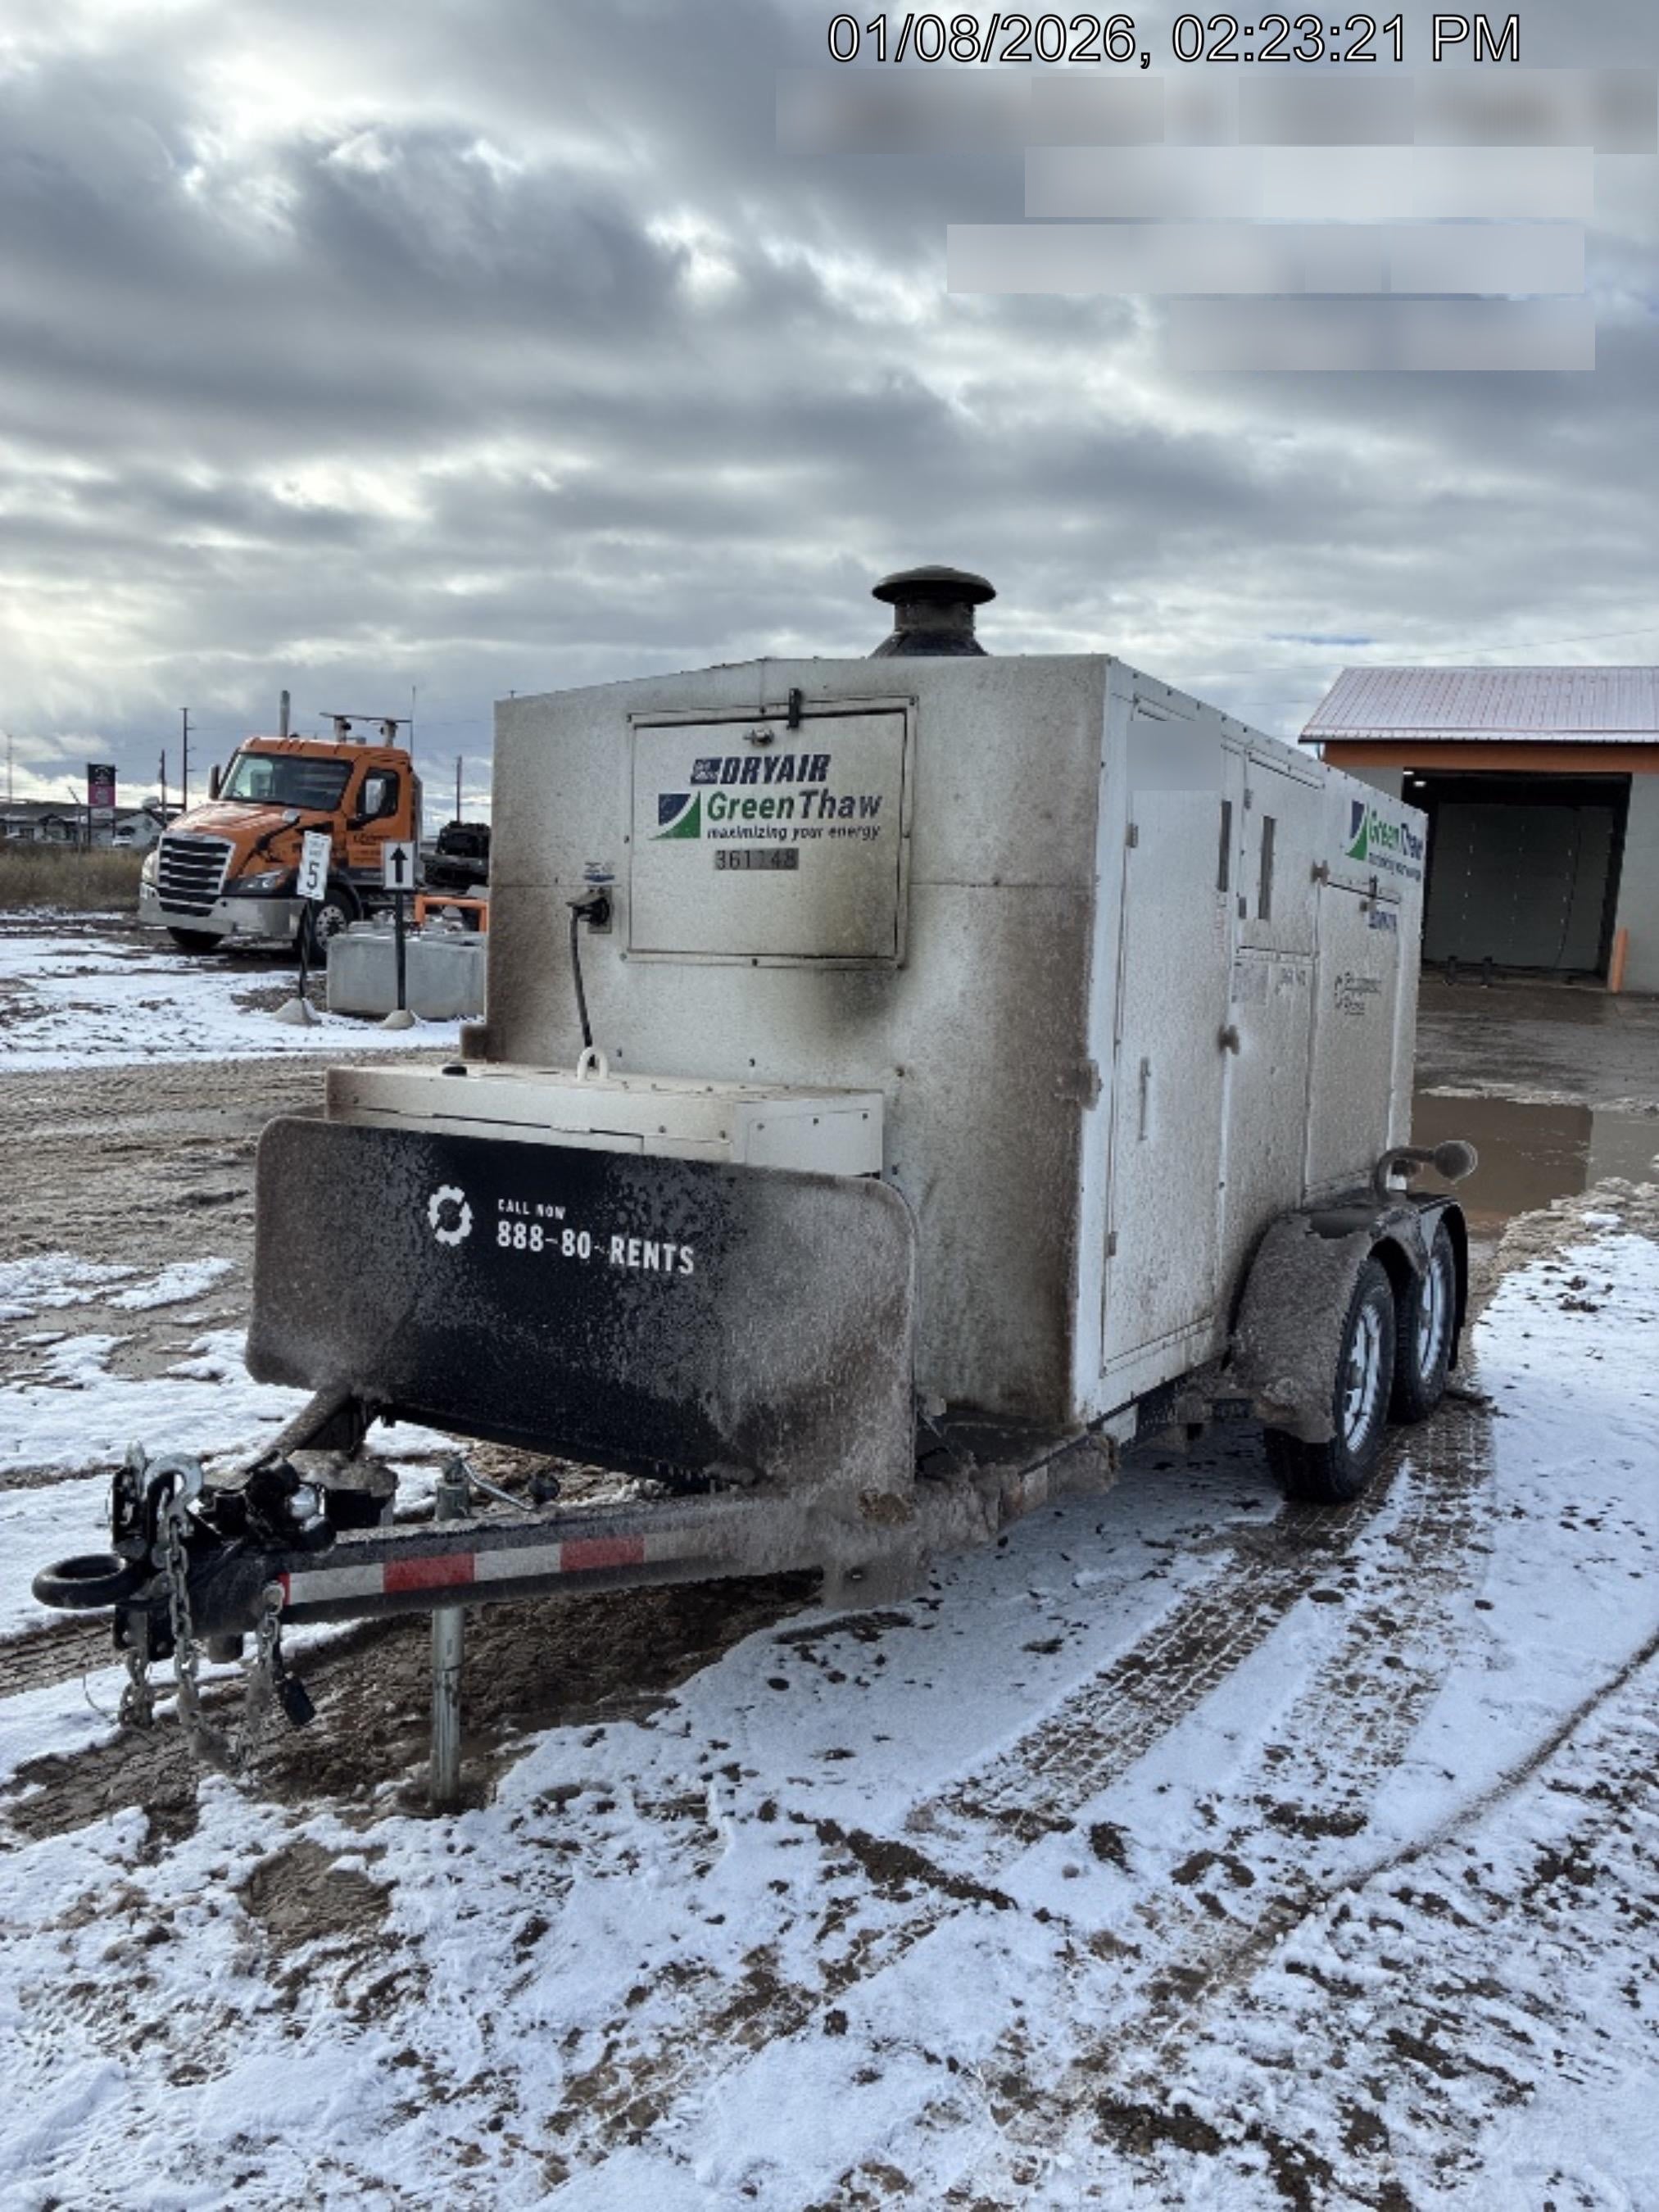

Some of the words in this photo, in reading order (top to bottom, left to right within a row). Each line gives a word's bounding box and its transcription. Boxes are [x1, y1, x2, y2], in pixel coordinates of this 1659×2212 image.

[720, 754, 832, 785] DRYAIR
[707, 788, 883, 821] GreenThaw
[707, 825, 787, 842] maximizing
[791, 826, 824, 842] your
[828, 825, 882, 841] energy
[306, 860, 320, 891] 5
[497, 1199, 530, 1216] CALL
[536, 1203, 566, 1220] NOW
